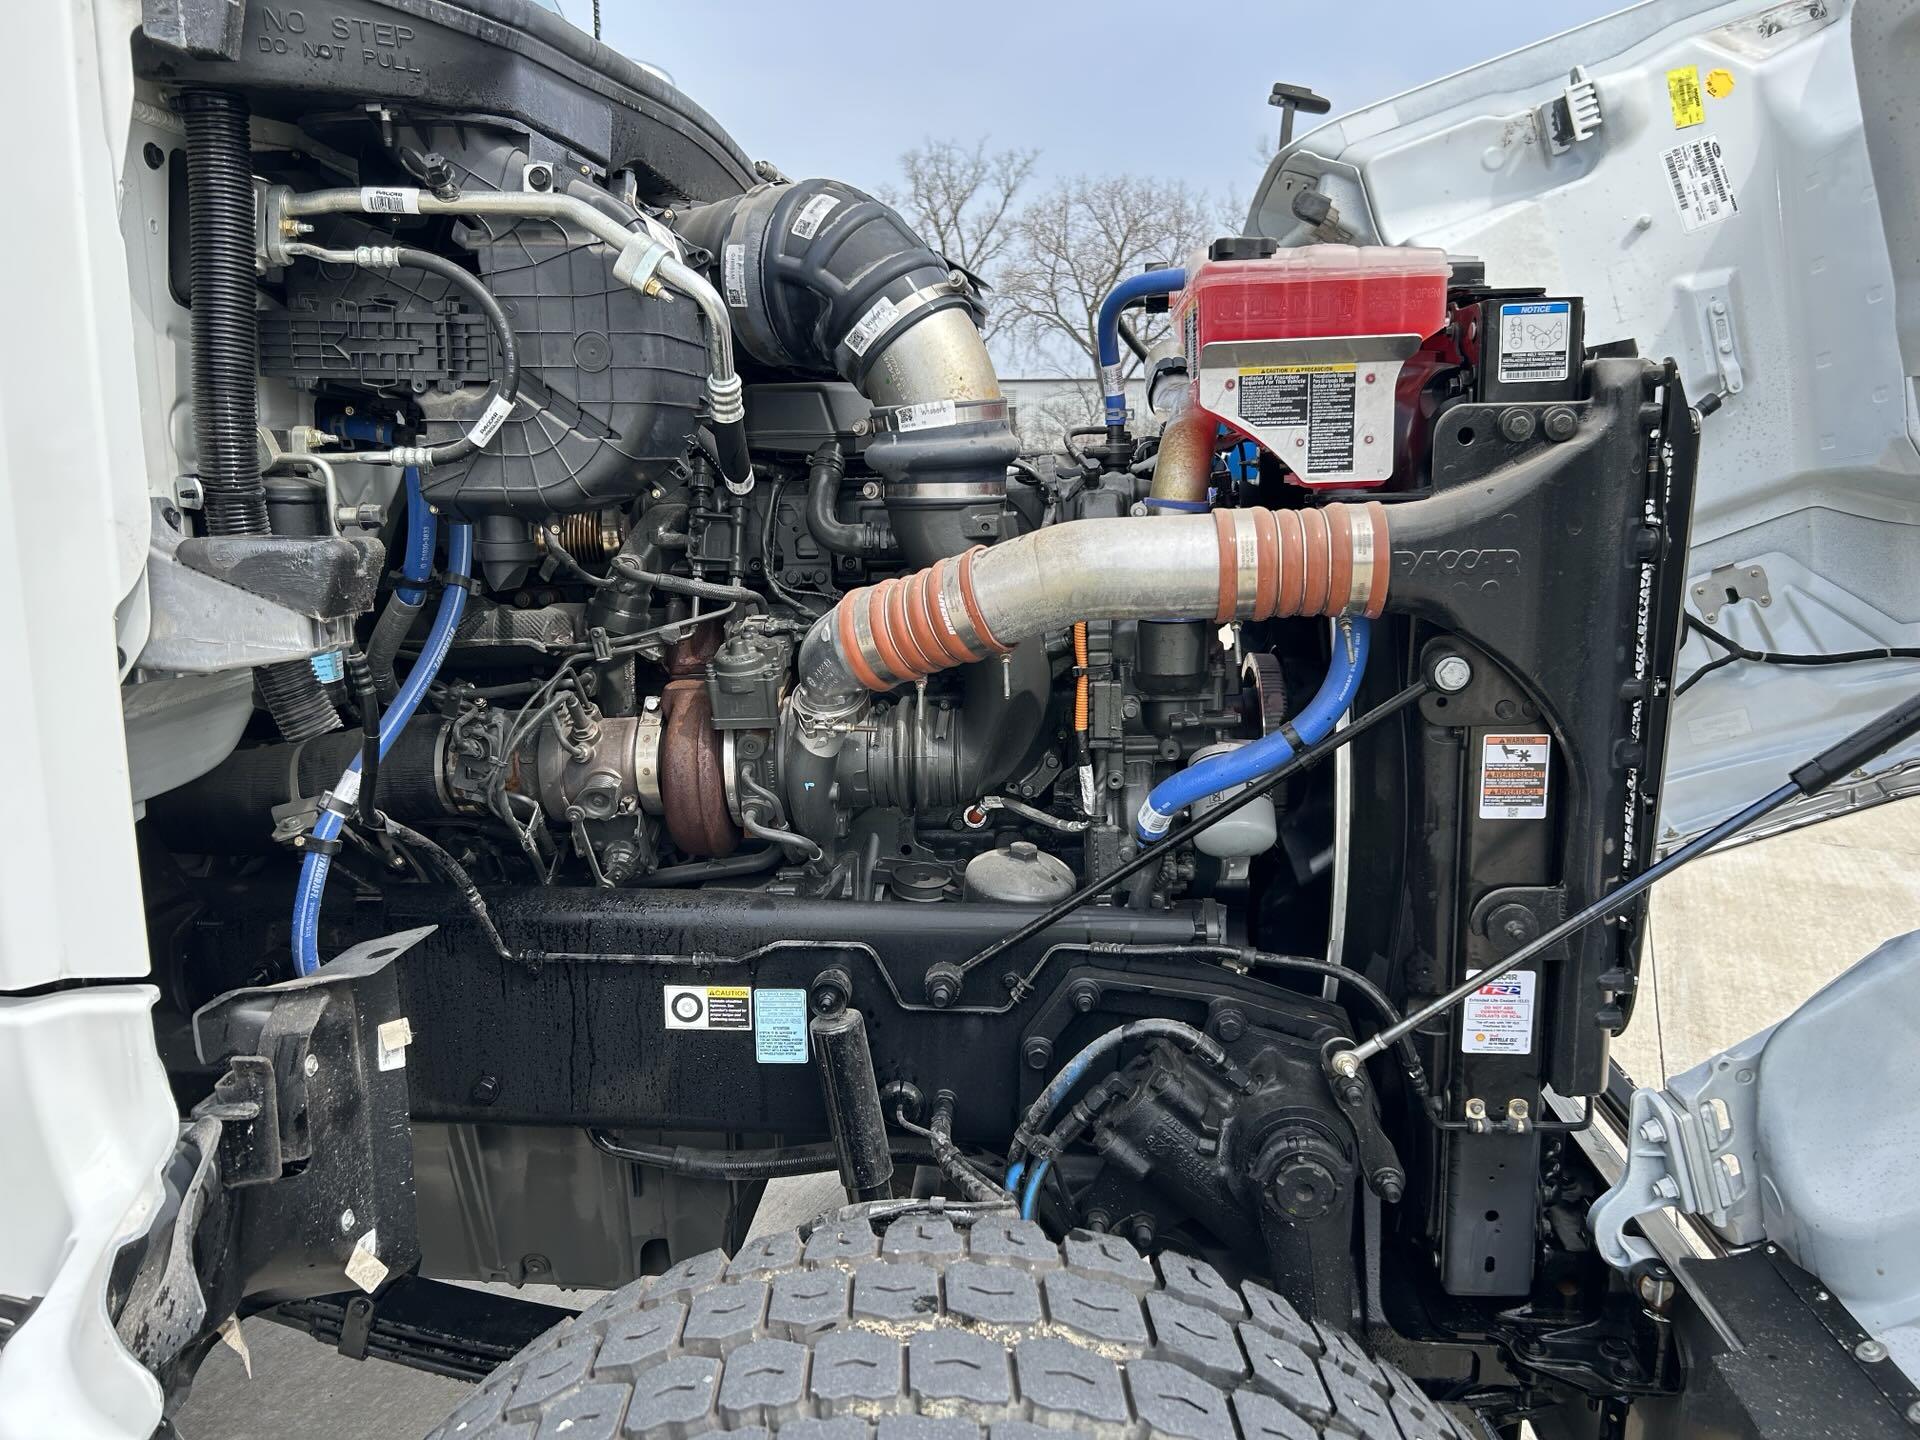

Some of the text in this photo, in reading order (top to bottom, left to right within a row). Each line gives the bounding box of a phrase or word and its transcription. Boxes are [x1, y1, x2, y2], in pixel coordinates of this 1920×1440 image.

[263, 6, 415, 48] NO STEP
[258, 35, 421, 73] DO NOT PULL
[1520, 305, 1552, 314] NOTICE
[1392, 549, 1521, 576] PACCAR
